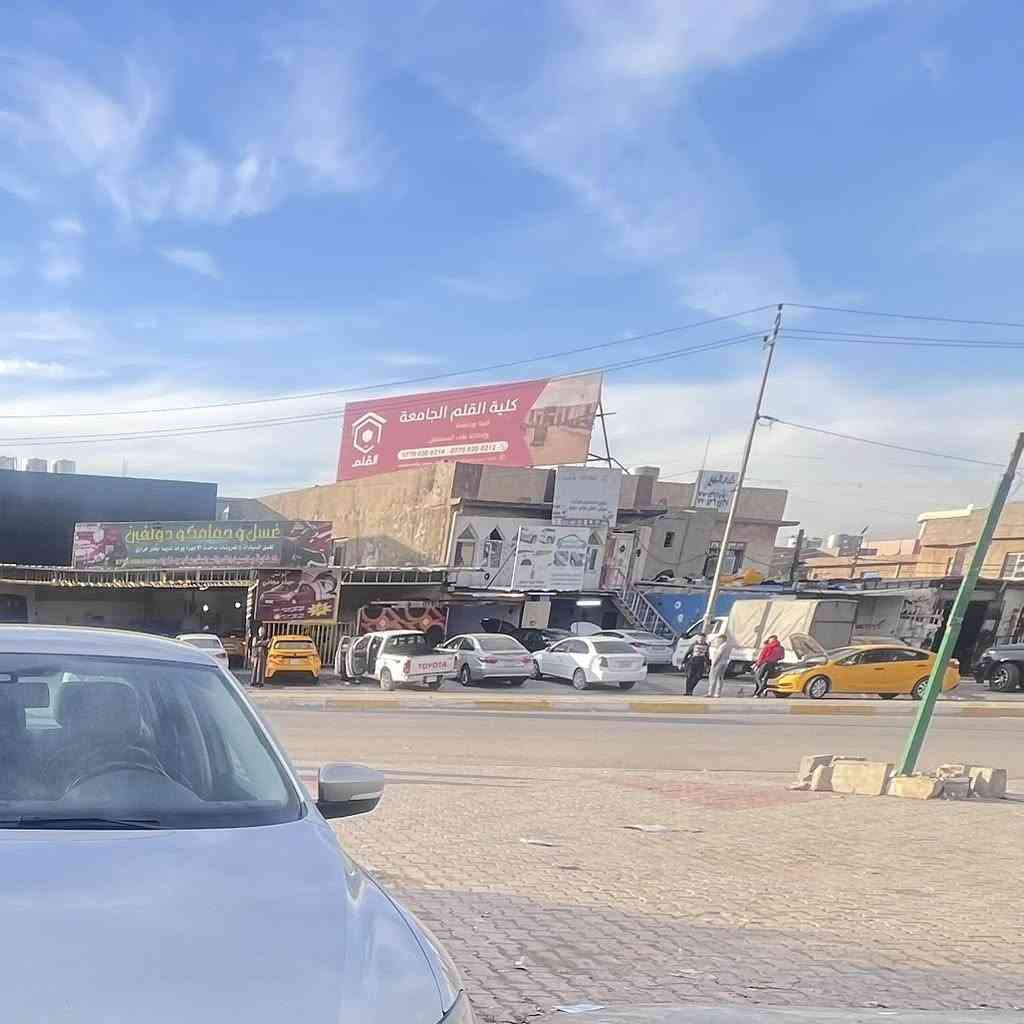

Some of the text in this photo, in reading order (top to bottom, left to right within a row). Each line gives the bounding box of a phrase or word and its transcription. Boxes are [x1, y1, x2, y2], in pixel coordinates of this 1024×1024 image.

[399, 399, 519, 423] كلية القلم الجامعة
[352, 454, 378, 468] القلم
[417, 661, 448, 671] TOYOTA
